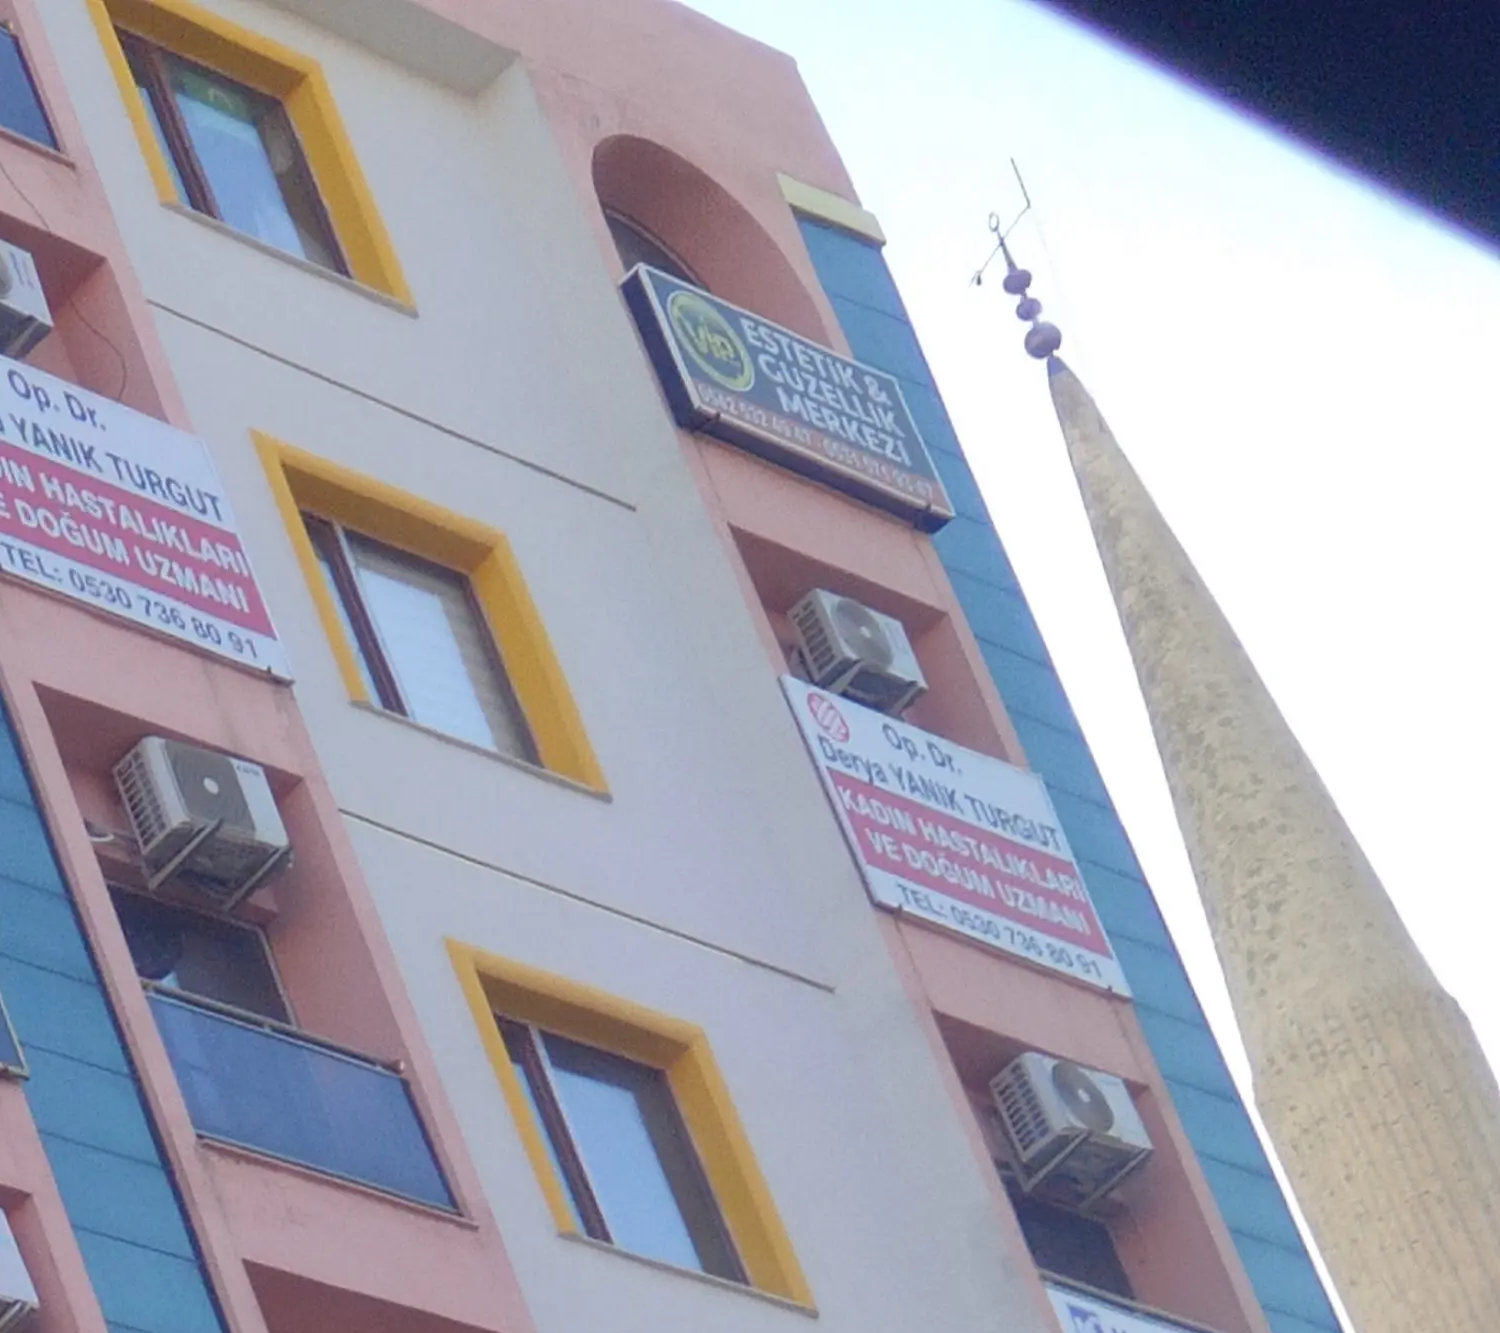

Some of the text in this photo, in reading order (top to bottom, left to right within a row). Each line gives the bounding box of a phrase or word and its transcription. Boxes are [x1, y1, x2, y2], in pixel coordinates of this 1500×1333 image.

[8, 370, 106, 430] Op. Dr.
[9, 414, 102, 474] YANIK
[106, 453, 223, 522] TURGUT
[16, 498, 129, 567] DOĞUM
[135, 546, 250, 613] UZMANI
[40, 473, 250, 577] HASTALIKLARI
[0, 543, 257, 659] TEL: 0530 736 91
[819, 736, 1063, 851] Derya YANIK TURGUT
